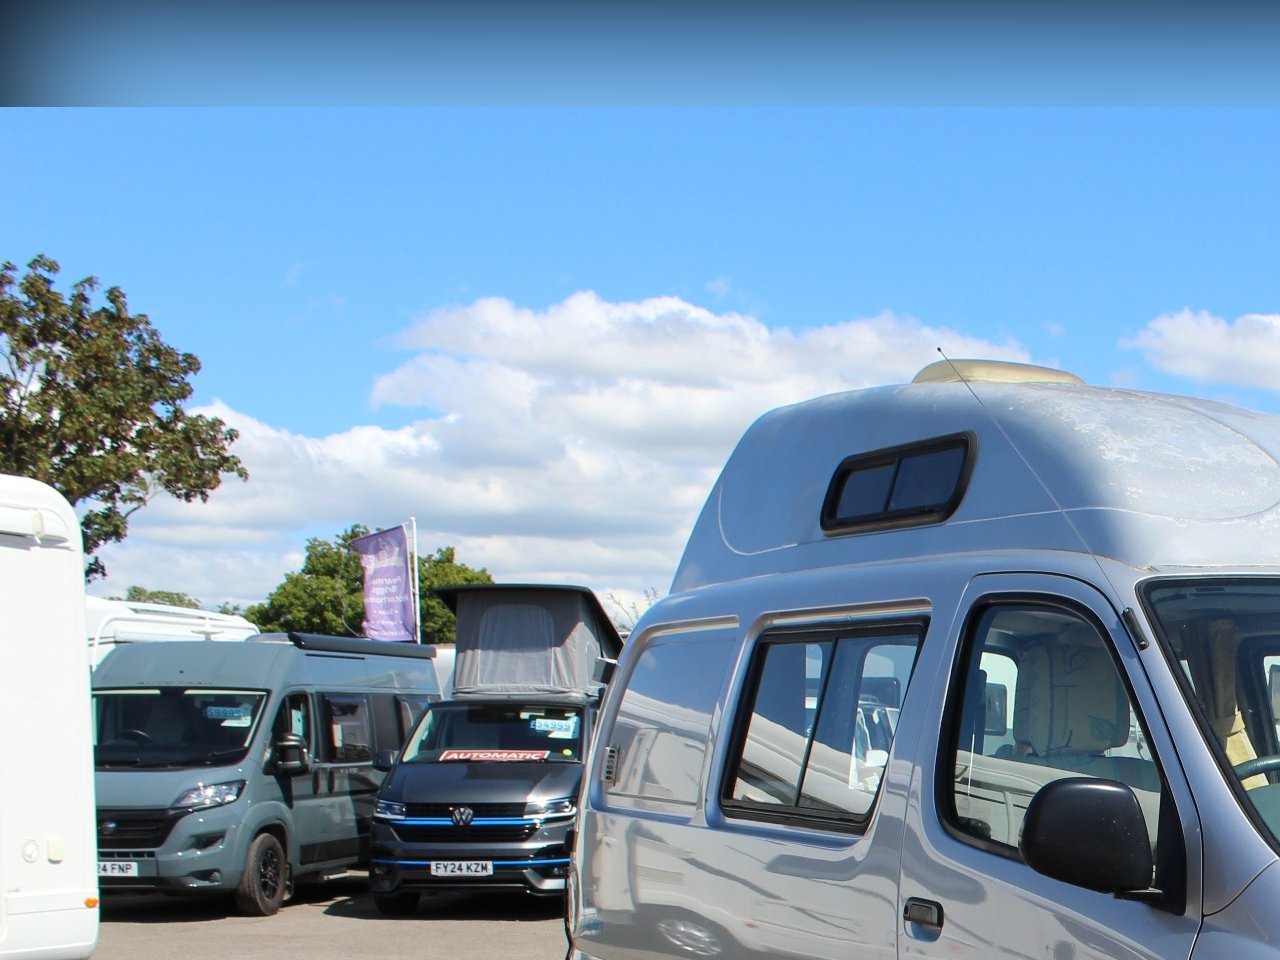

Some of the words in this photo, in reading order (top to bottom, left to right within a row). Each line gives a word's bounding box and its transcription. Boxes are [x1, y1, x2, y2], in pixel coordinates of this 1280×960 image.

[446, 752, 542, 760] AUTOMATIC
[111, 863, 132, 873] FNP
[435, 863, 463, 873] FY24
[466, 863, 488, 873] KZM
